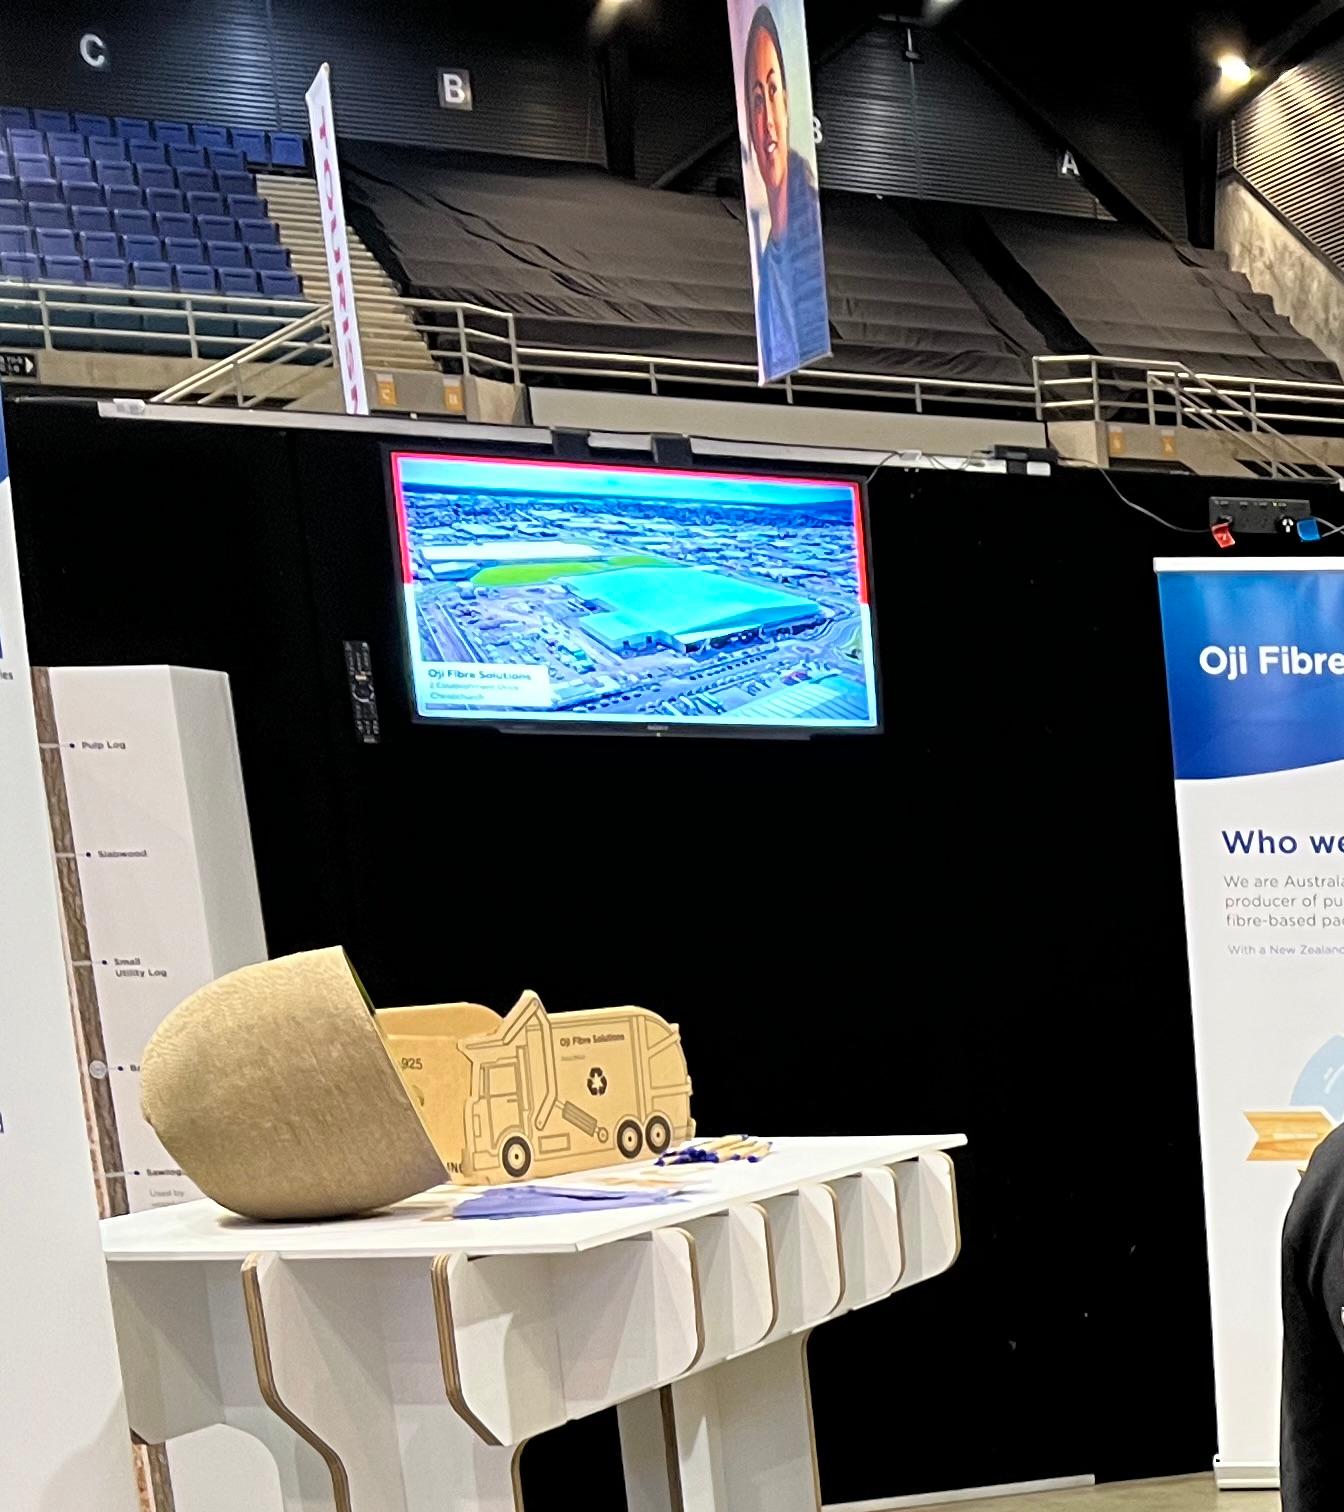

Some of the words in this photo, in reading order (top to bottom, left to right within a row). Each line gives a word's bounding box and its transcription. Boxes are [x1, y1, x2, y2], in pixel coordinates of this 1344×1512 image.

[80, 35, 106, 67] C
[443, 73, 465, 104] B
[1060, 152, 1080, 175] A
[1199, 645, 1248, 680] Oji
[1221, 829, 1298, 854] Who
[1223, 875, 1249, 888] We
[1254, 877, 1279, 888] are
[1225, 894, 1296, 909] producer
[1302, 894, 1318, 908] of
[1226, 913, 1316, 927] fibre-based
[1228, 944, 1257, 955] With
[1258, 946, 1266, 955] a
[1270, 944, 1296, 955] New
